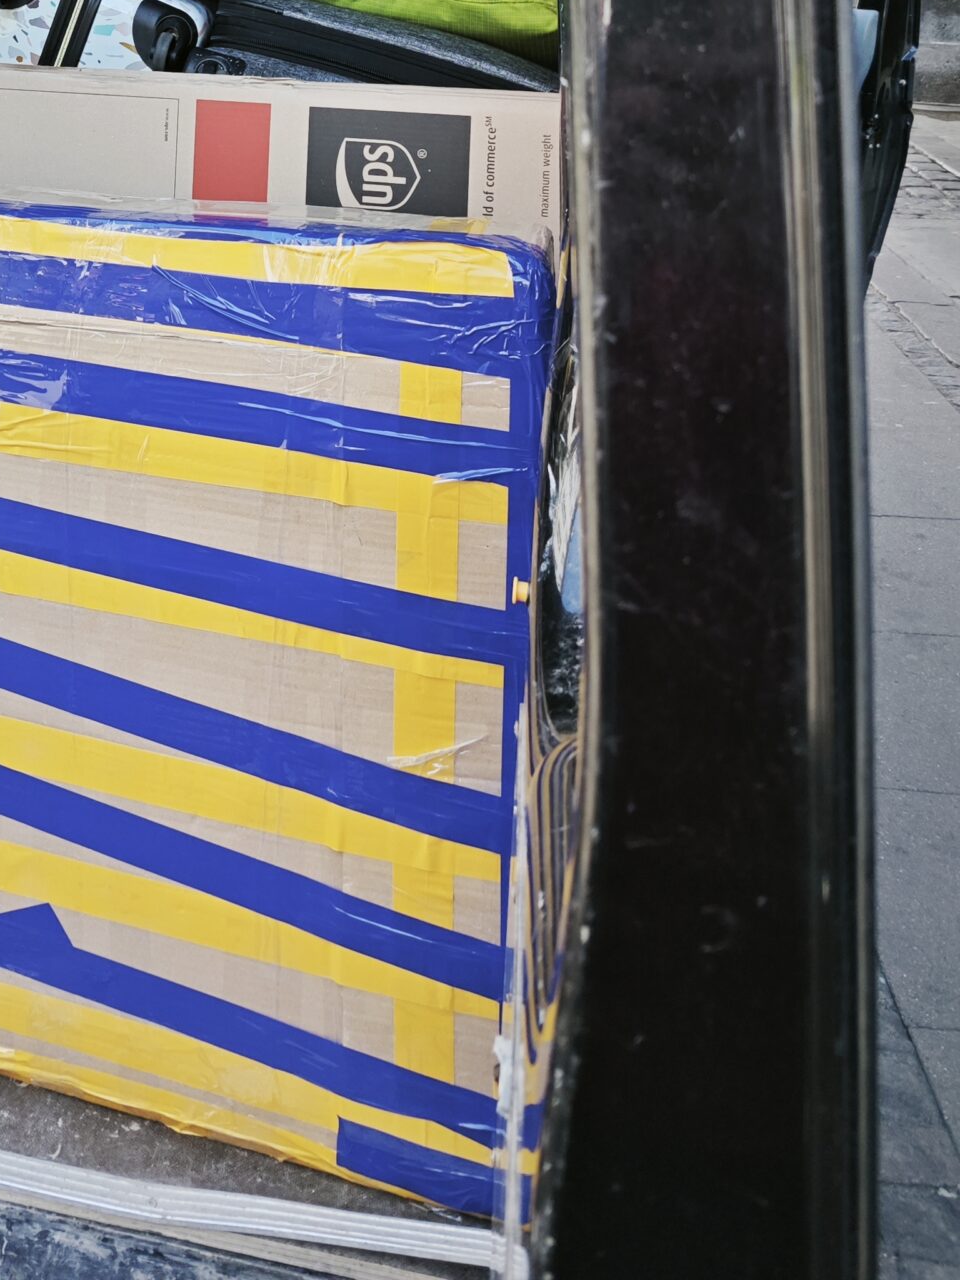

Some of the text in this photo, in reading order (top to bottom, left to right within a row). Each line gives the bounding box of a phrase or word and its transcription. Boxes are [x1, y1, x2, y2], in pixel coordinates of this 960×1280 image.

[483, 190, 495, 202] of
[539, 134, 554, 218] maximum weight
